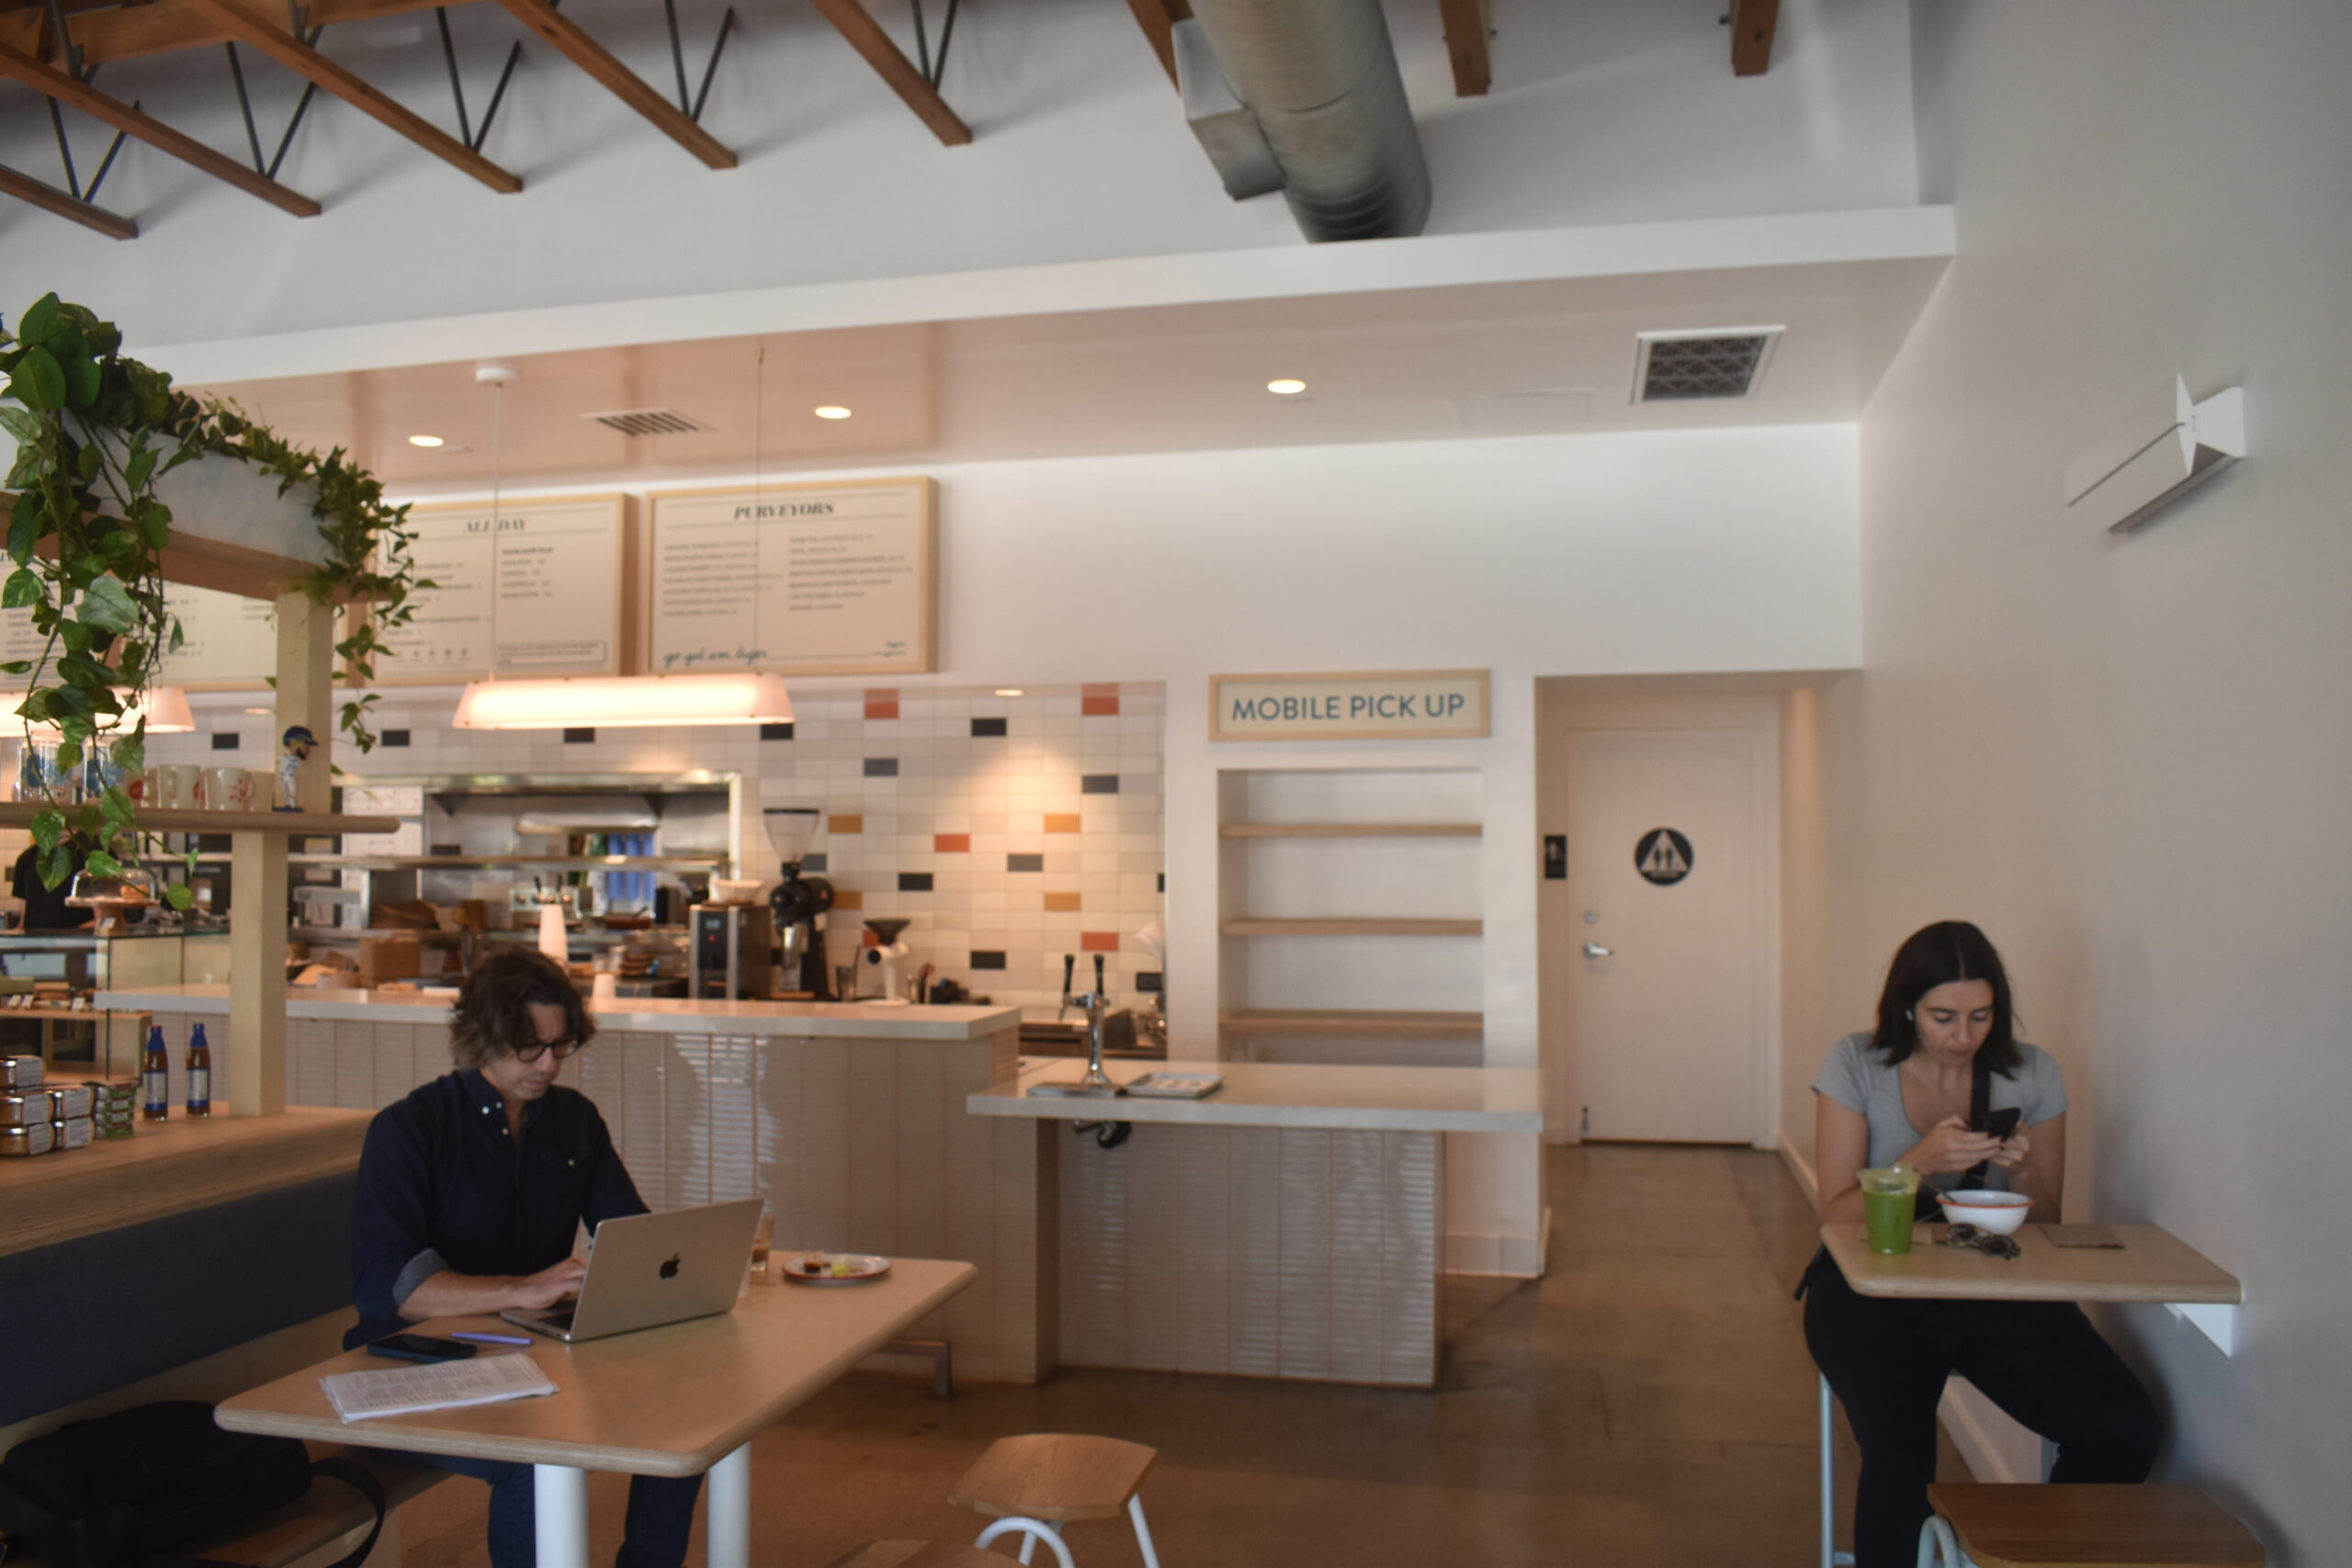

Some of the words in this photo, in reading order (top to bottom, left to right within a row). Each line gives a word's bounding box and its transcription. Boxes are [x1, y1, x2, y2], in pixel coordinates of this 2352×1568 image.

[734, 502, 834, 520] PURVEYORS
[464, 520, 491, 534] ALL
[496, 517, 526, 532] DAY
[1231, 695, 1341, 721] MOBILE
[1351, 694, 1417, 719] PICK
[1425, 693, 1464, 717] UP
